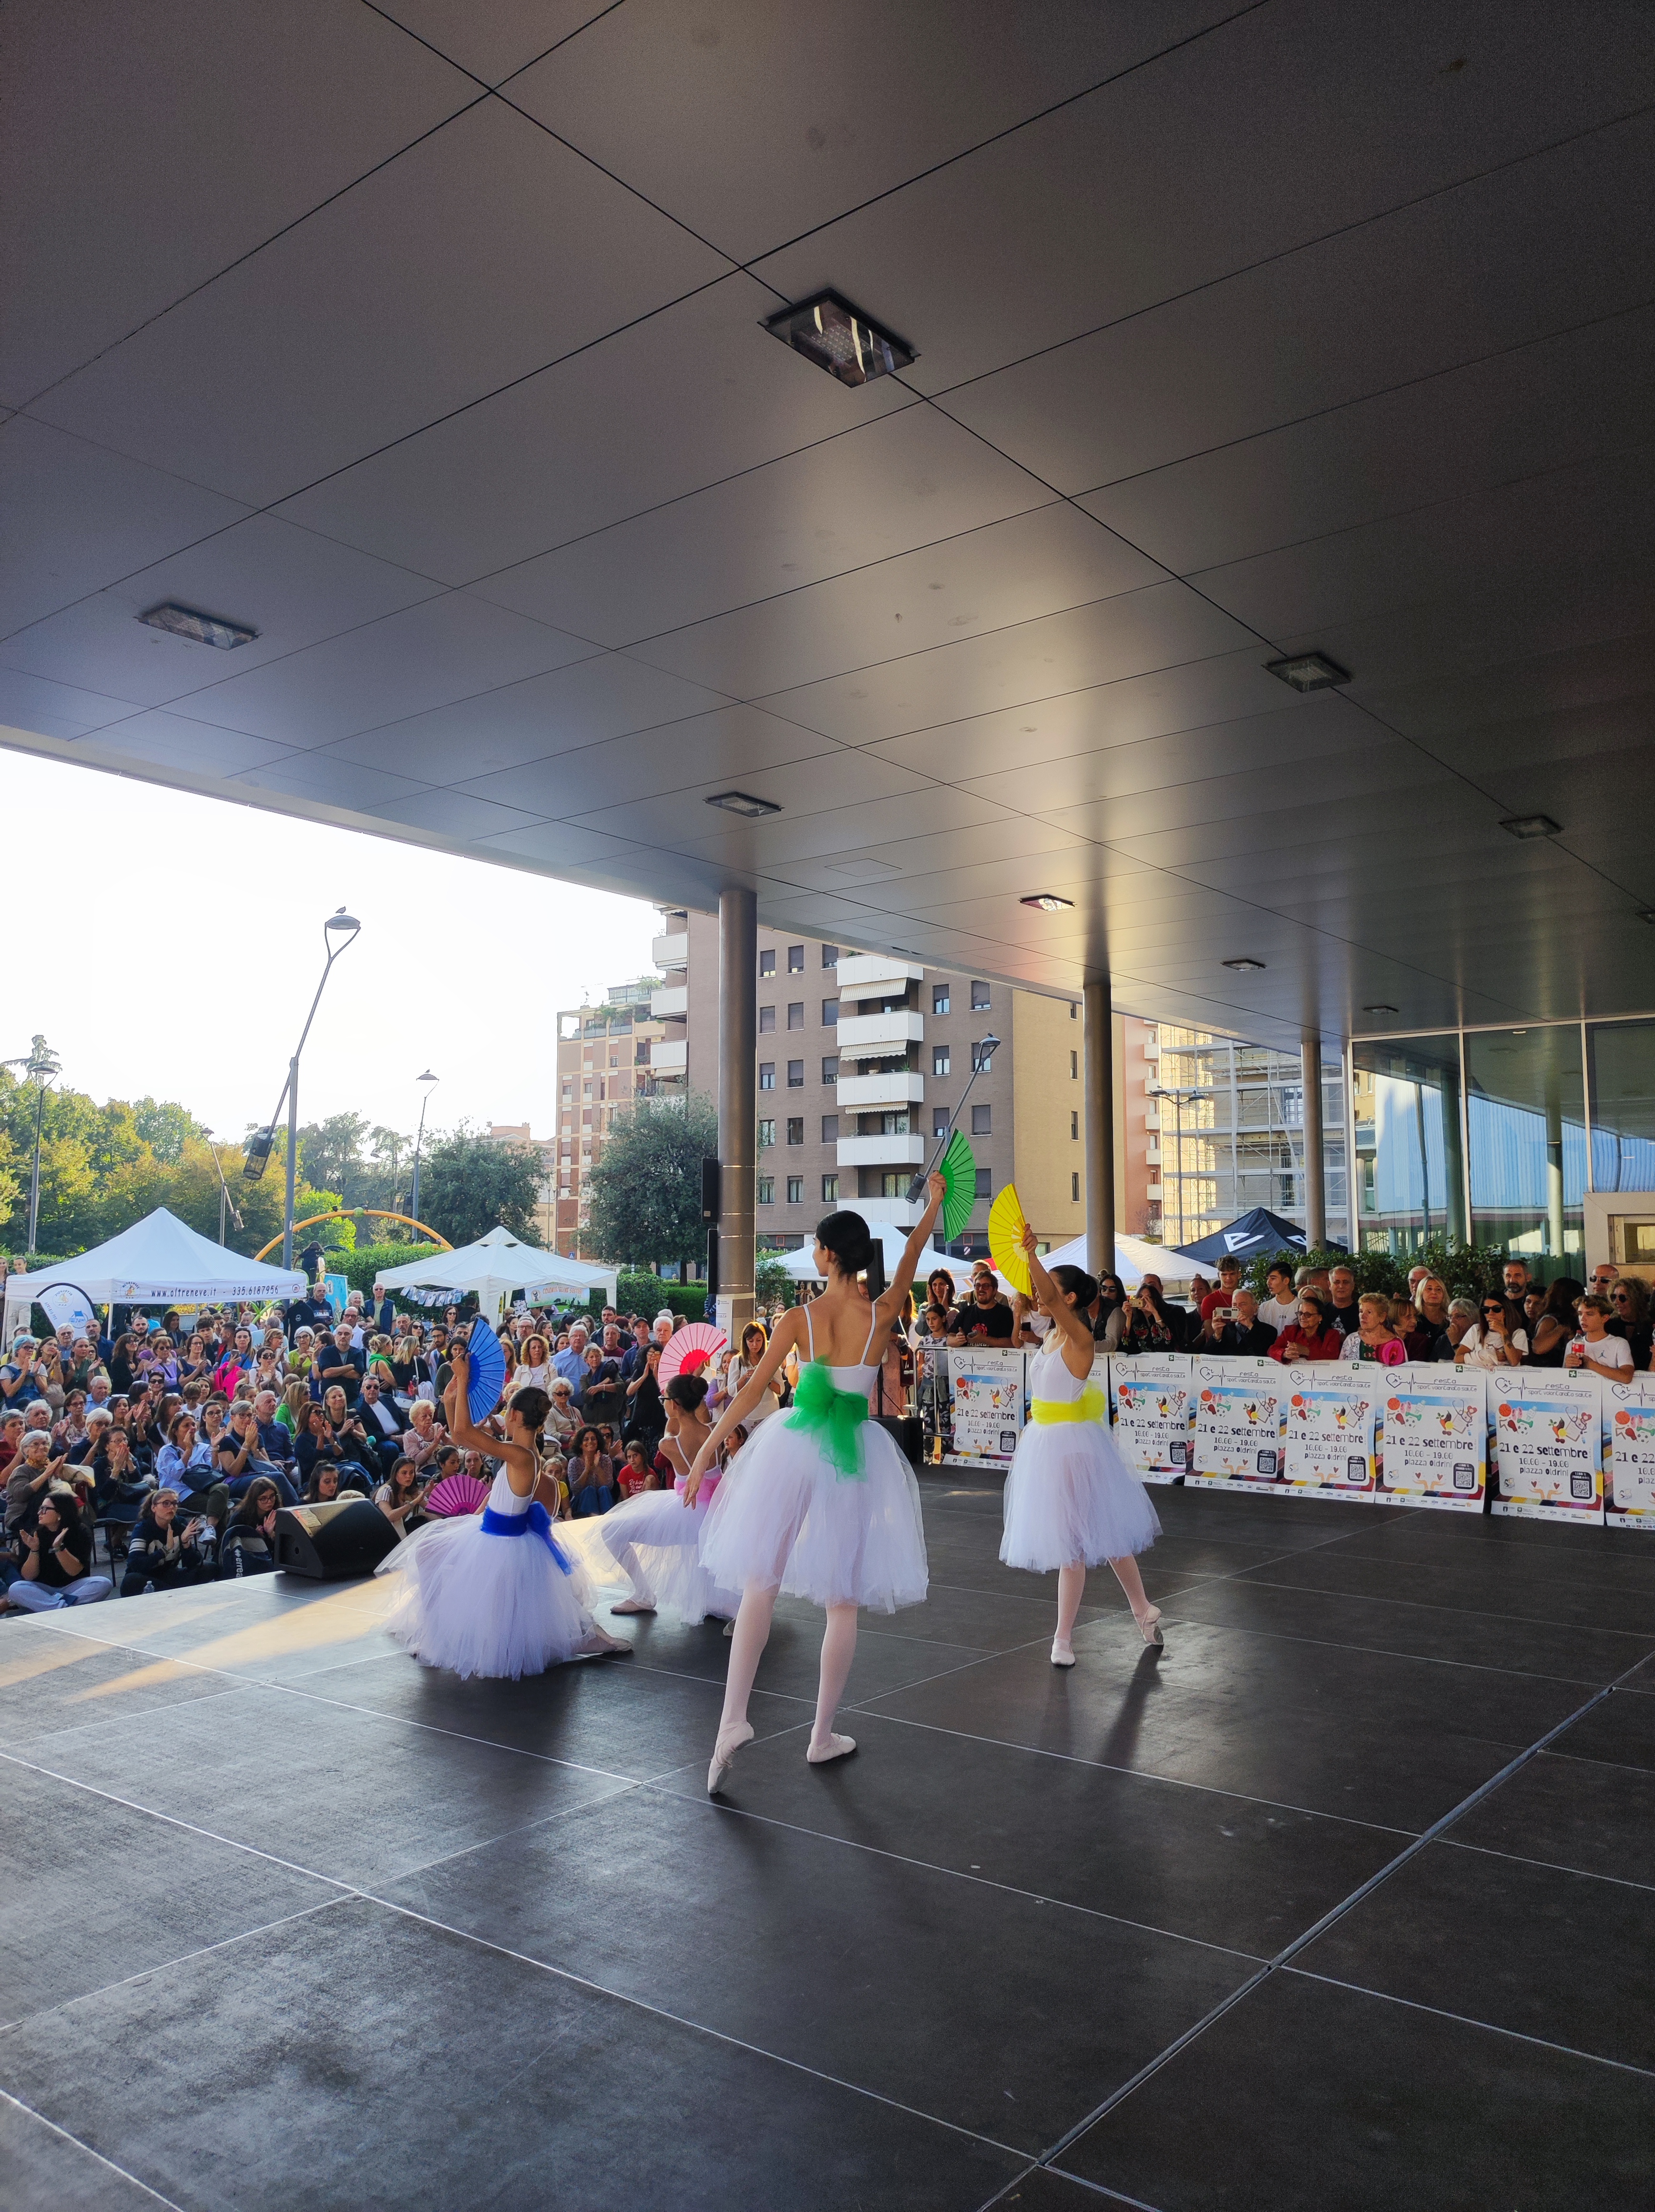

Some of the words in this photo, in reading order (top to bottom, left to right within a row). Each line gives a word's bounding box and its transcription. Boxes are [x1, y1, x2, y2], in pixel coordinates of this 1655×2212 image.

[151, 1287, 216, 1297] www.oltreneve.it
[232, 1285, 279, 1296] 335.6187956
[971, 1409, 979, 1417] 22
[980, 1411, 1015, 1420] settembre
[1120, 1418, 1128, 1426] 21
[1136, 1419, 1145, 1427] 22
[1147, 1421, 1185, 1430] settembre
[1197, 1423, 1208, 1432] 21
[1217, 1425, 1229, 1434] 22
[1231, 1427, 1276, 1438] settembre
[1288, 1430, 1298, 1439] 21
[1309, 1432, 1319, 1440] 22
[1320, 1433, 1364, 1443] settembre
[1385, 1435, 1397, 1444] 21
[1408, 1436, 1420, 1446] 22
[1423, 1439, 1473, 1450] settembre
[1499, 1443, 1511, 1452] 21
[1513, 1445, 1519, 1453] e
[1522, 1444, 1534, 1454] 22
[1537, 1446, 1588, 1458] settembre
[1615, 1452, 1628, 1462] 21
[1632, 1454, 1638, 1462] e
[1641, 1453, 1655, 1463] 22
